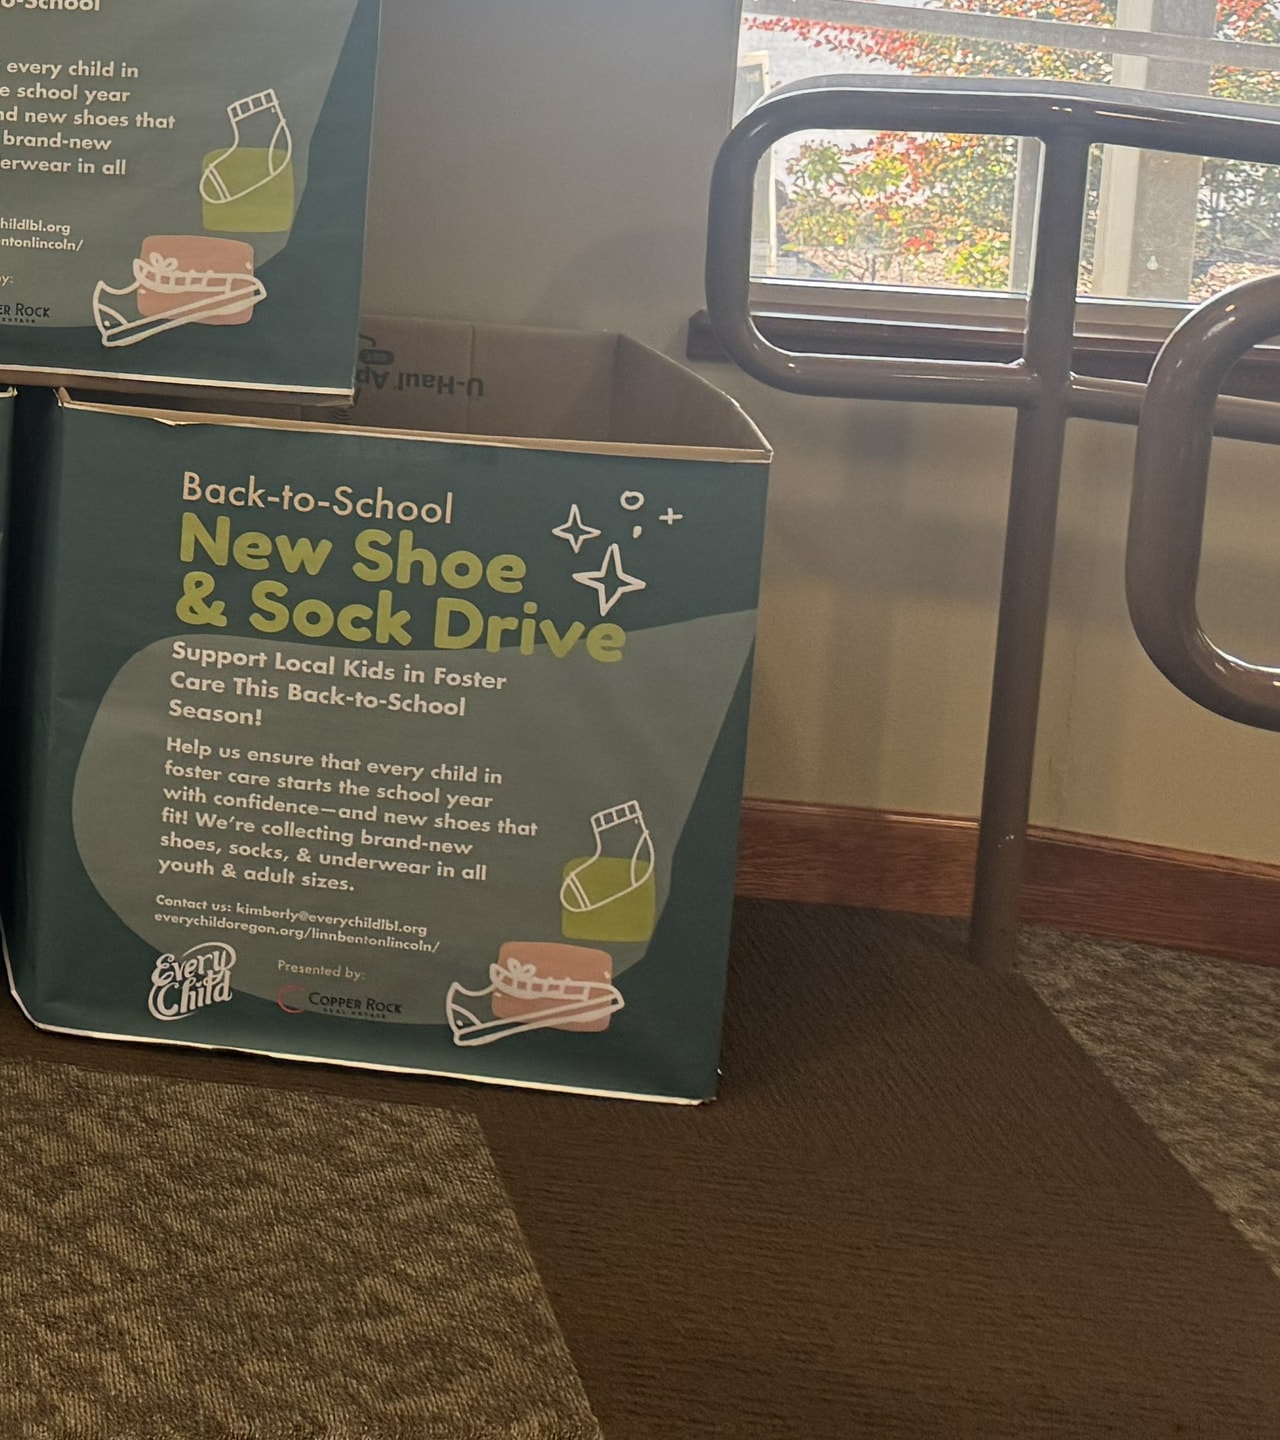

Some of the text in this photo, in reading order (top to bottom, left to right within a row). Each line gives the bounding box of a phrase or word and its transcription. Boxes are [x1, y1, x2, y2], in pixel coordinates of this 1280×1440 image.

[24, 111, 67, 124] new
[73, 108, 128, 127] shoes
[135, 111, 175, 129] that
[397, 371, 485, 397] U-Haul
[184, 472, 453, 525] Back-to-School
[181, 513, 527, 595] New Shoe
[176, 571, 628, 665] & Sock Drive
[156, 894, 427, 937] Contact us: kimberly@everychildlbl.org
